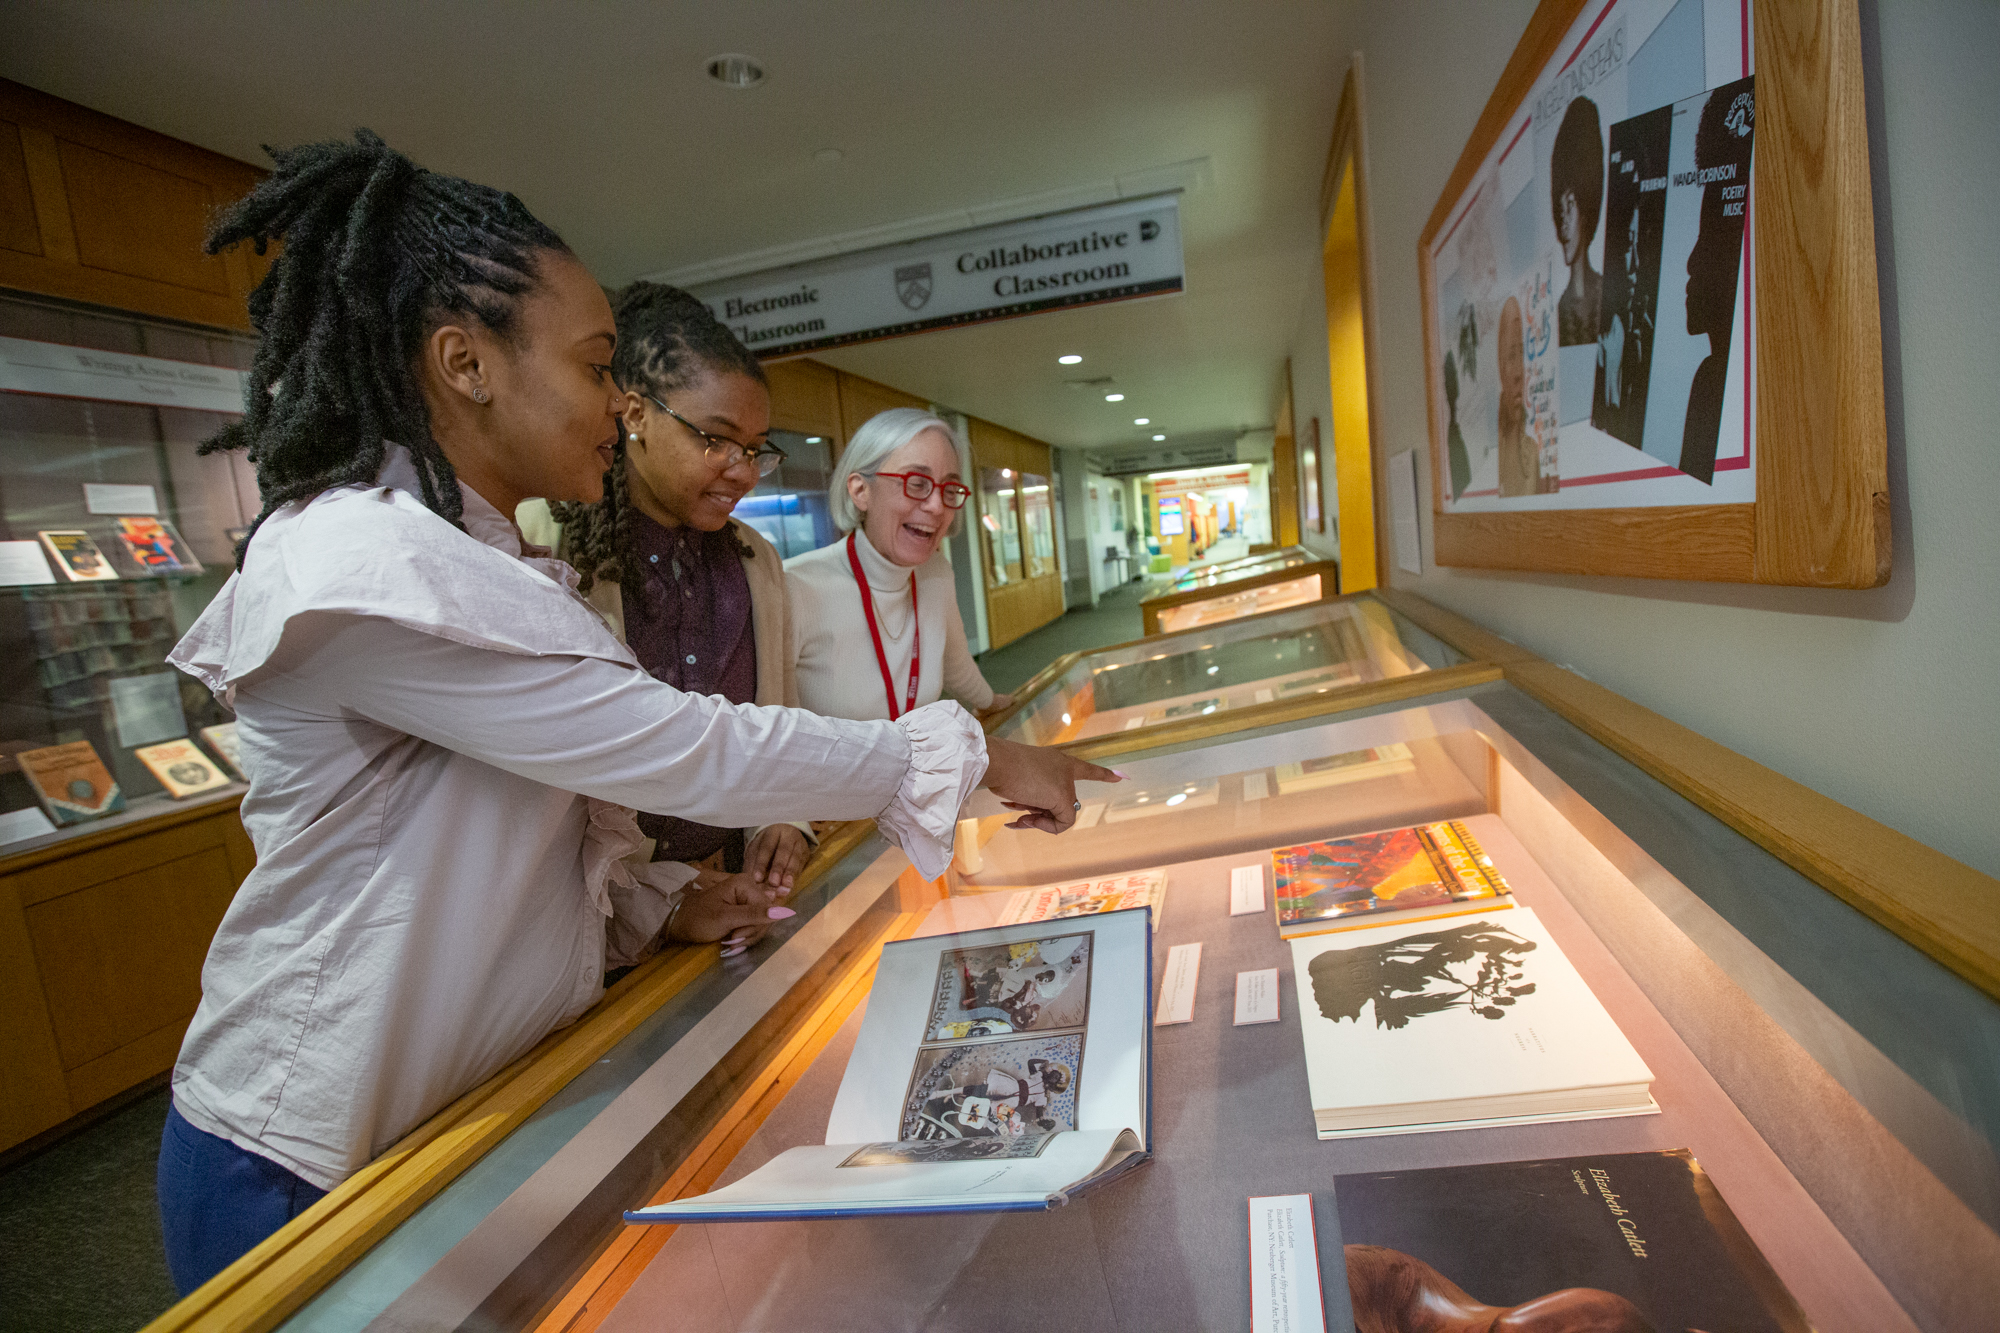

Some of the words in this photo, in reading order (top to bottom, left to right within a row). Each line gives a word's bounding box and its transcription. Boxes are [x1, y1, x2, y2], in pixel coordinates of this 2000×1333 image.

[1673, 170, 1697, 188] WANDA
[1698, 163, 1737, 185] ROBINSON
[1721, 184, 1747, 201] POETRY
[1723, 202, 1745, 216] MUSIC
[956, 230, 1129, 274] Collaborative
[993, 260, 1130, 298] Classroom
[725, 284, 819, 319] Electronic
[1276, 1208, 1284, 1230] Elizabeth
[1588, 1168, 1628, 1215] Elizabeth
[1617, 1219, 1648, 1258] Catlett
[1268, 1244, 1276, 1272] Neuberger
